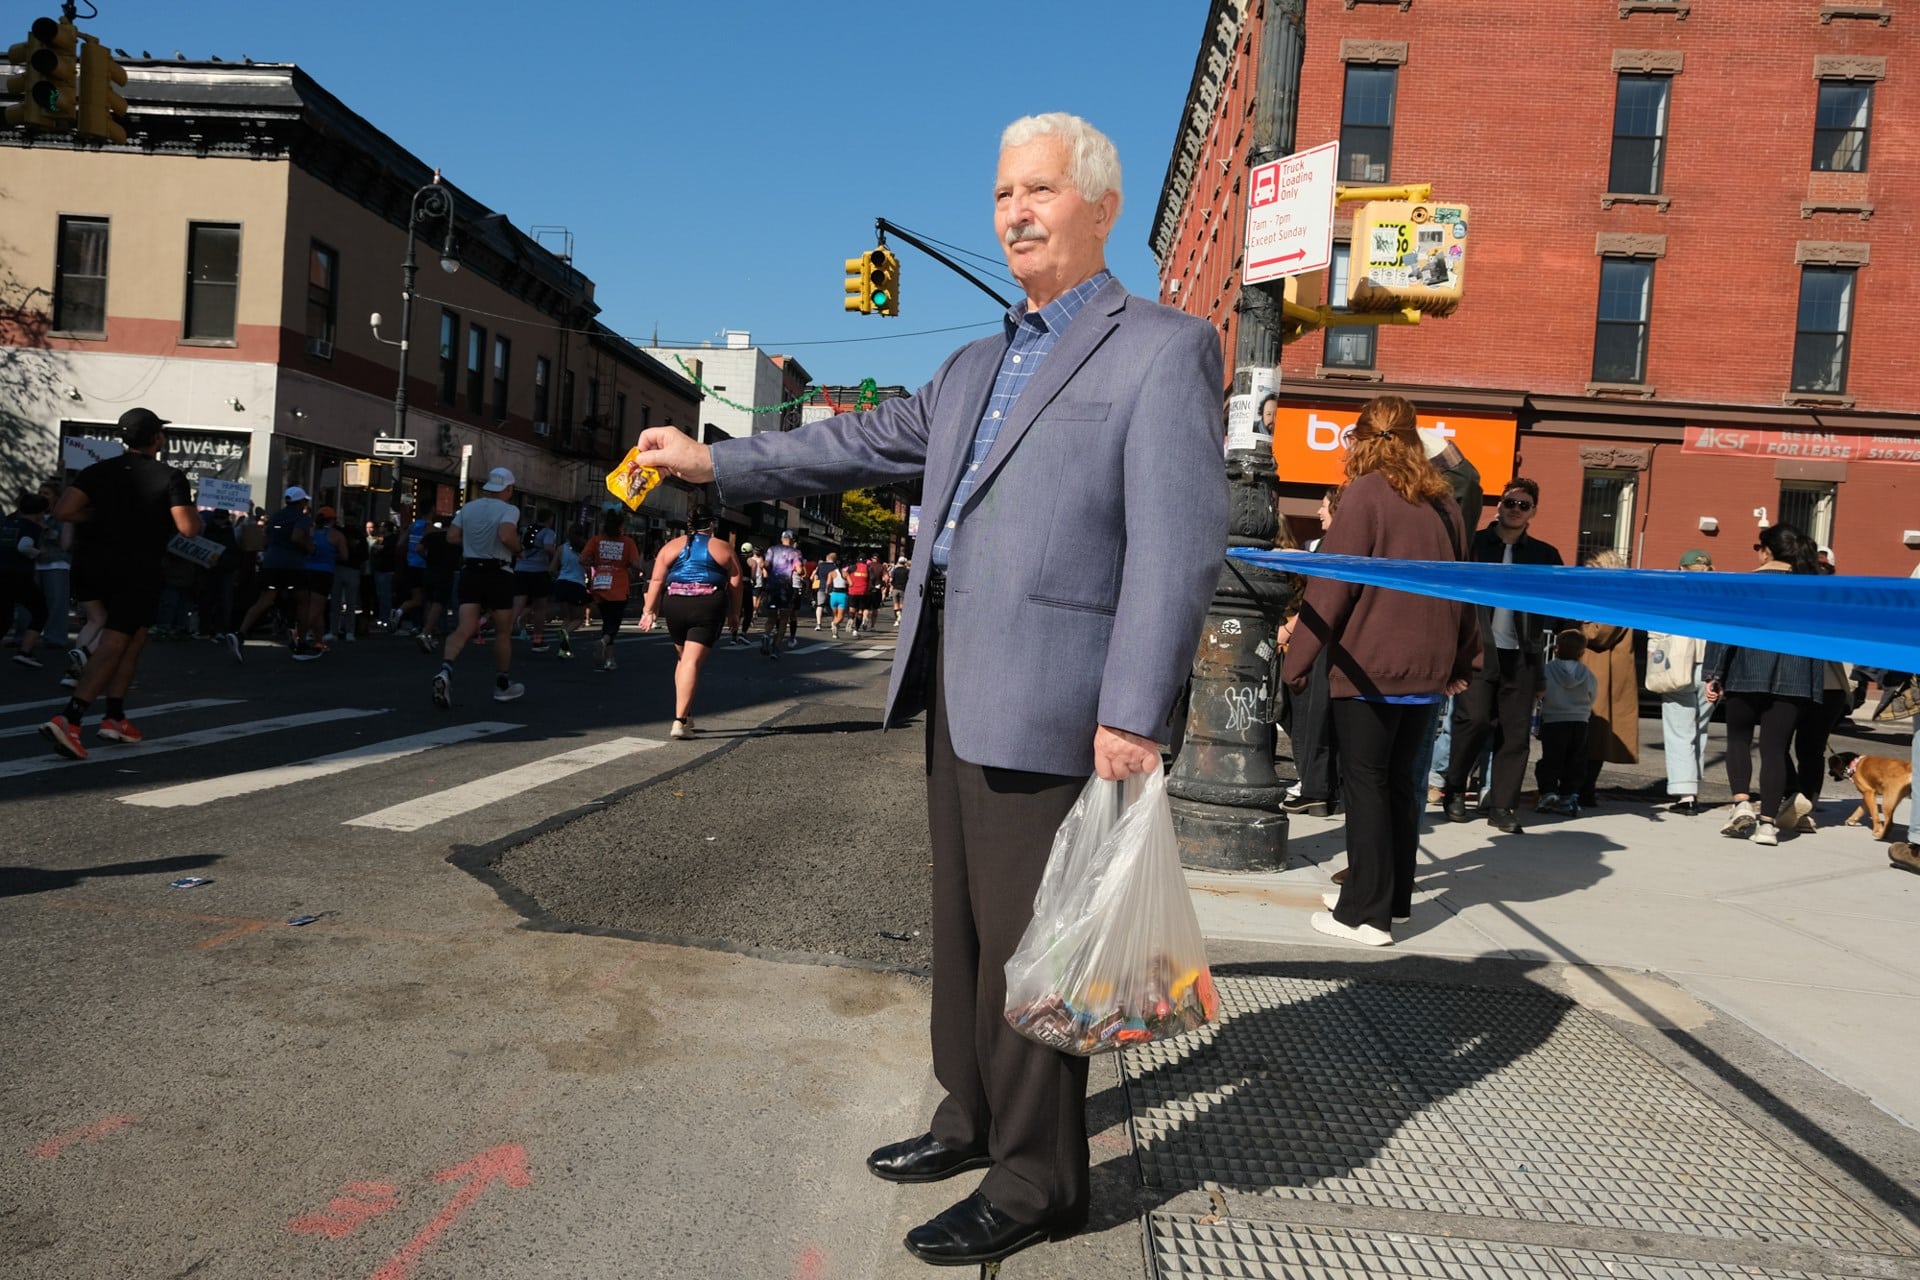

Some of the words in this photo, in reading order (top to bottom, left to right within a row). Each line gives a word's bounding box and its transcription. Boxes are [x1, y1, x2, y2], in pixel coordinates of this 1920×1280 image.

[1283, 160, 1305, 175] Truck
[1281, 171, 1313, 188] Loading
[1280, 187, 1299, 201] Only
[1252, 220, 1267, 230] 7am
[1276, 213, 1291, 226] 7pm
[1251, 232, 1277, 248] Except
[1278, 225, 1307, 241] Sunday
[1781, 431, 1838, 443] RETAIL
[1766, 442, 1798, 455] FOR
[1801, 444, 1851, 458] LEASE
[222, 481, 249, 492] HUMBLE
[171, 536, 211, 560] RACHEL
